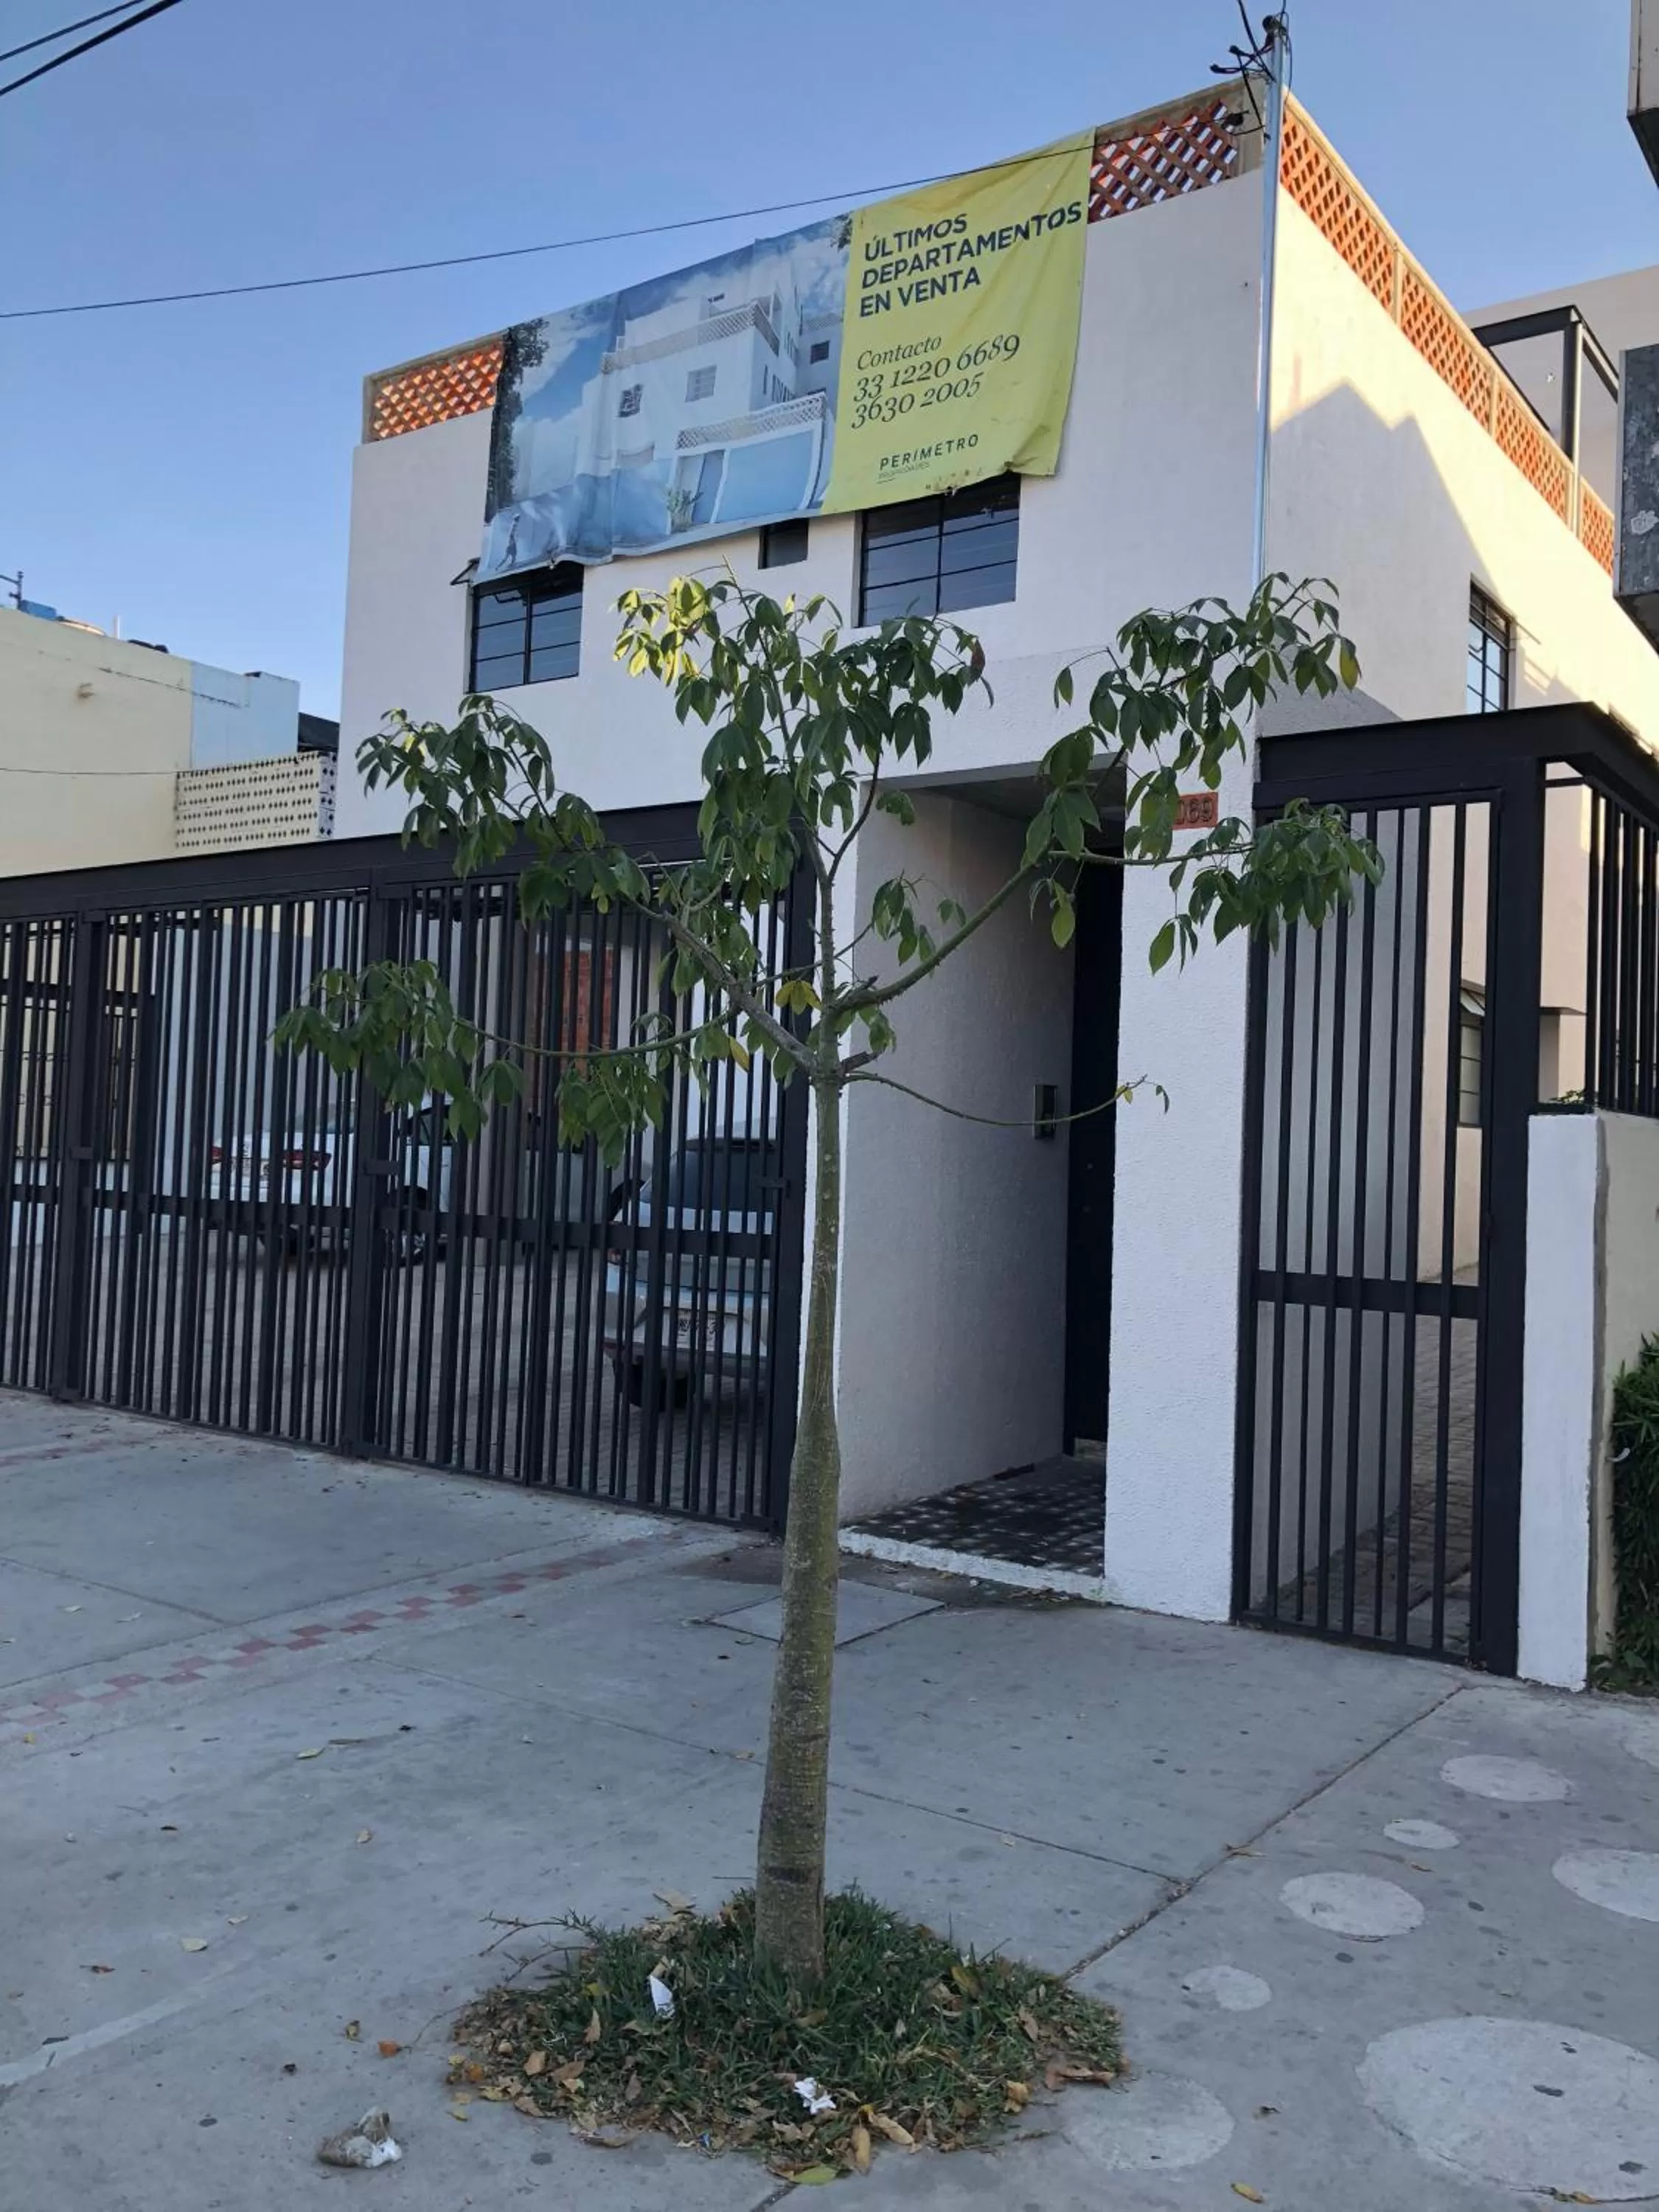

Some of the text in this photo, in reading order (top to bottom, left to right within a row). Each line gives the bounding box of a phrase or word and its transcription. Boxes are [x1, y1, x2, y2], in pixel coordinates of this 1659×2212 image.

[862, 201, 1082, 289] DEPARTAMENTOS
[864, 213, 967, 262] ÚLTIMOS
[860, 266, 981, 317] EN VENTA
[853, 334, 1020, 403] 33 1220 6689
[858, 335, 942, 370] Contacto
[852, 371, 984, 429] 3630 2005
[880, 434, 978, 470] PERIMETRO
